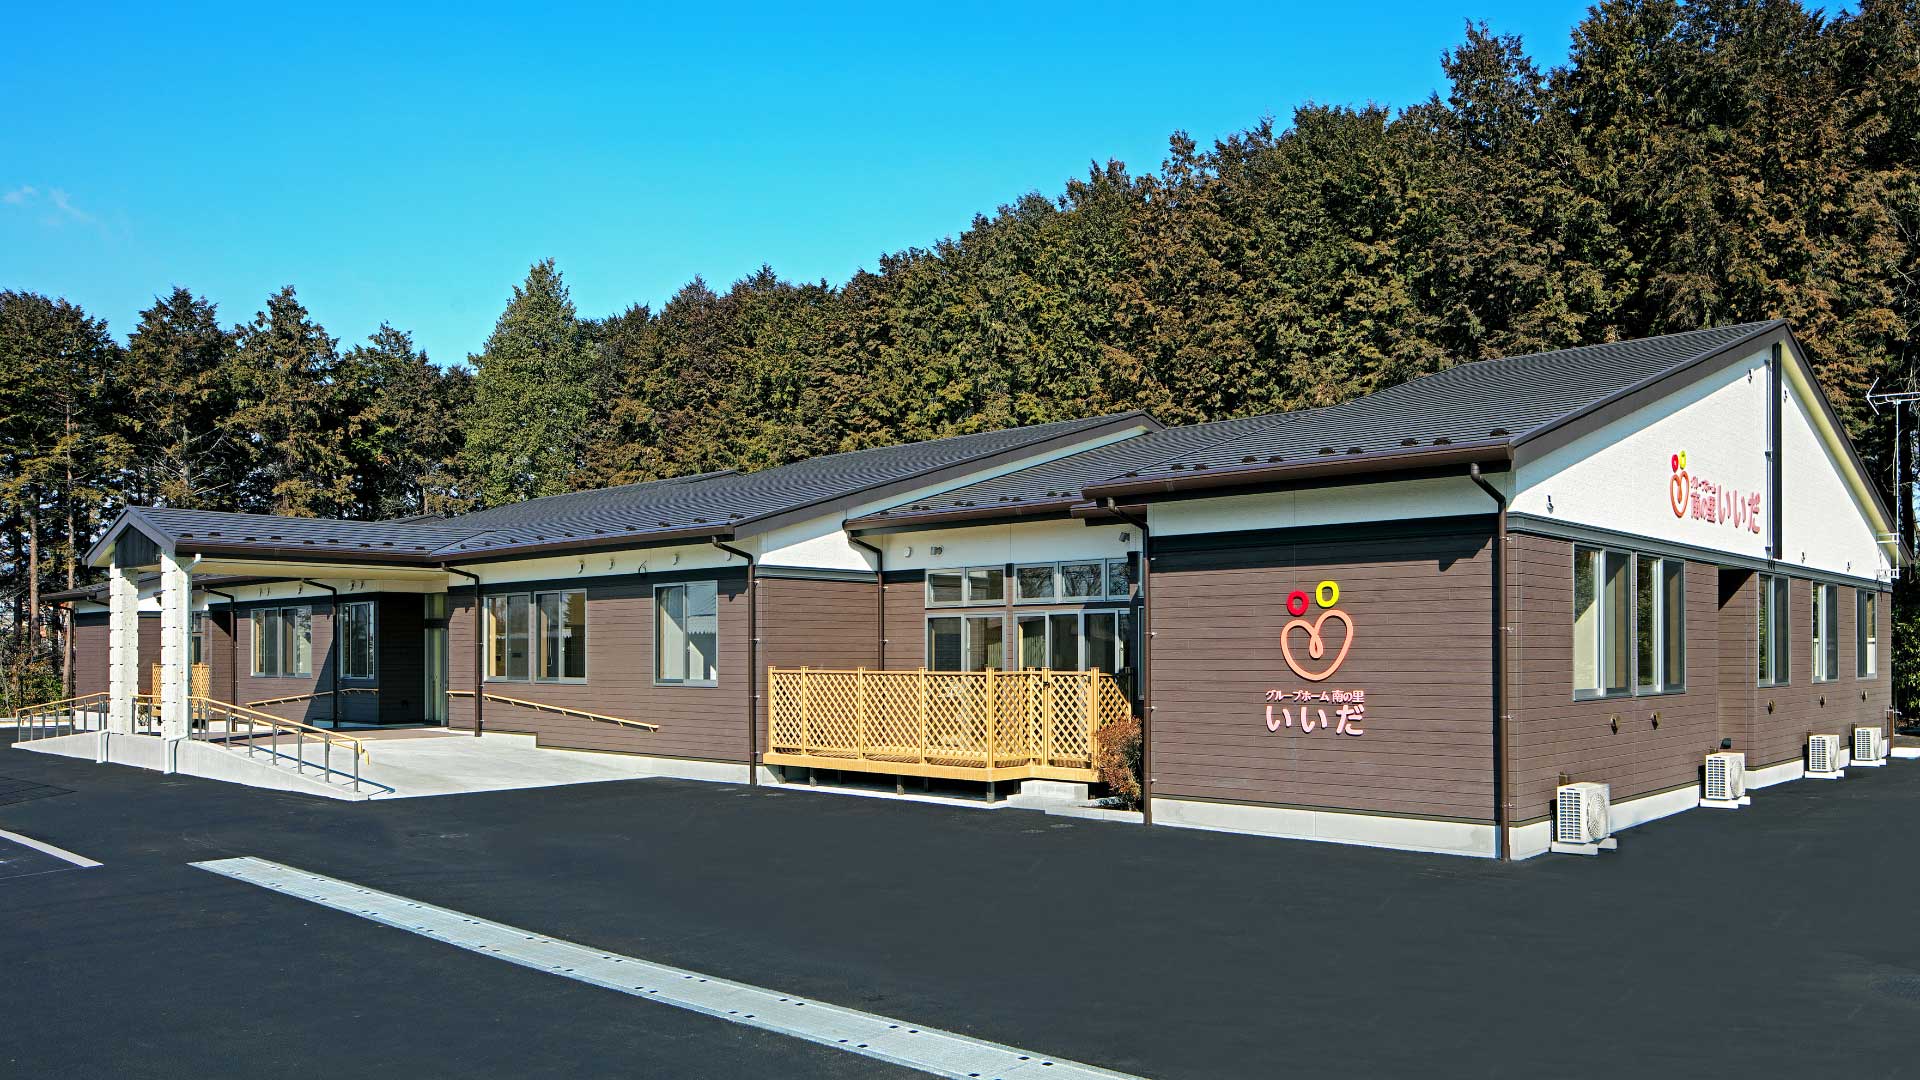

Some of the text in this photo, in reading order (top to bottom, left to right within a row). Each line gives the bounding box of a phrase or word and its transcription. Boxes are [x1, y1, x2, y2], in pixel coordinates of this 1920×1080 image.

[1717, 484, 1761, 534] いいだ
[1265, 689, 1364, 703] グループホーム 南の里
[1266, 704, 1364, 735] いいだ
